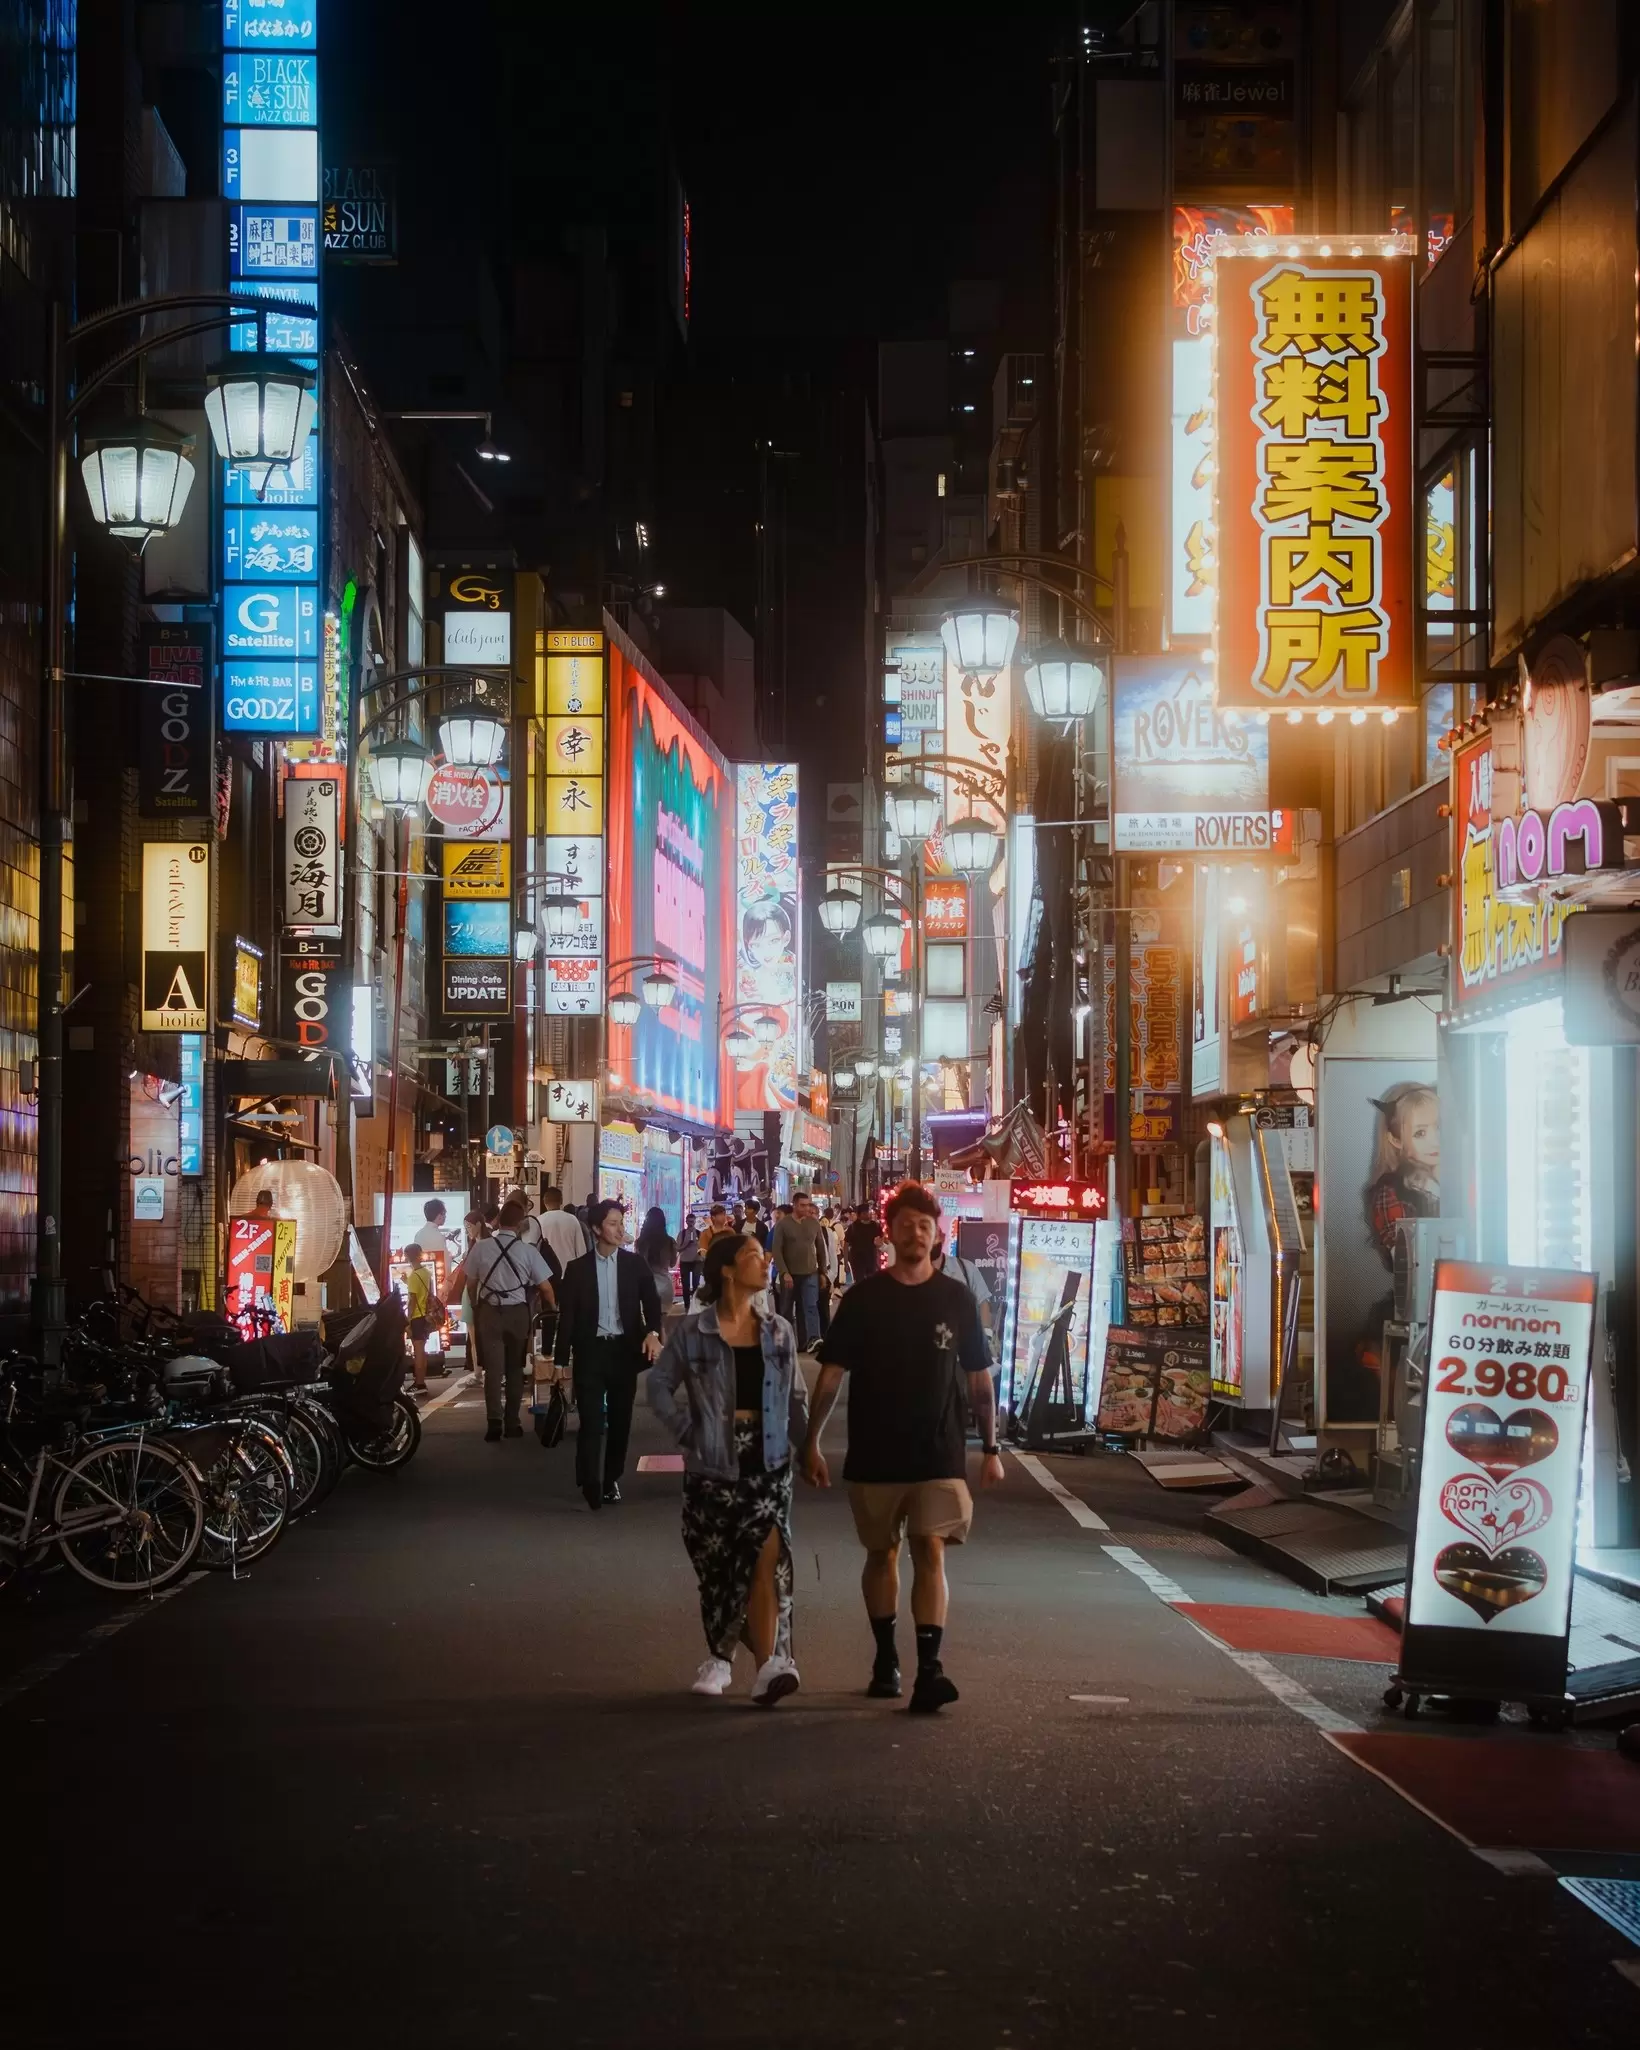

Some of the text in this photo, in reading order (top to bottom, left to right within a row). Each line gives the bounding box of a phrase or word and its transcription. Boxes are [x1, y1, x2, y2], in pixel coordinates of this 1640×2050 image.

[253, 58, 310, 85] BLACK
[225, 72, 239, 105] 4F
[274, 85, 310, 110] SUN
[254, 110, 310, 122] JAZZ CLUB
[226, 148, 239, 184] 3F
[341, 201, 388, 233] SUN
[249, 221, 273, 242] 麻雀
[324, 234, 387, 249] AZZ CLUB
[1260, 269, 1382, 694] 無料案内所
[227, 527, 240, 563] 1F
[244, 543, 315, 573] 海月
[238, 593, 281, 633] G
[227, 634, 294, 648] Satellite
[272, 677, 294, 688] BAR
[227, 697, 295, 721] GODZ
[439, 769, 453, 779] FIRE
[319, 784, 333, 795] 1F
[432, 780, 484, 810] 消火栓
[561, 781, 592, 812] 永
[1195, 815, 1268, 847] ROVERS
[289, 858, 333, 919] 海月
[925, 896, 966, 919] 麻雀
[298, 941, 325, 953] B-1
[548, 959, 599, 971] MEXICAN
[555, 969, 591, 982] FOOD
[451, 975, 502, 985] Dining Cafe
[447, 987, 507, 1000] UPDATE
[551, 1083, 590, 1120] すし半
[236, 1219, 259, 1239] 2F
[278, 1222, 288, 1240] 2F
[1476, 1300, 1549, 1314] ガールズバー
[1462, 1313, 1561, 1336] nomnom
[1449, 1335, 1571, 1360] 60分飲み放題
[1444, 1483, 1488, 1499] nom
[1444, 1497, 1487, 1513] nom
